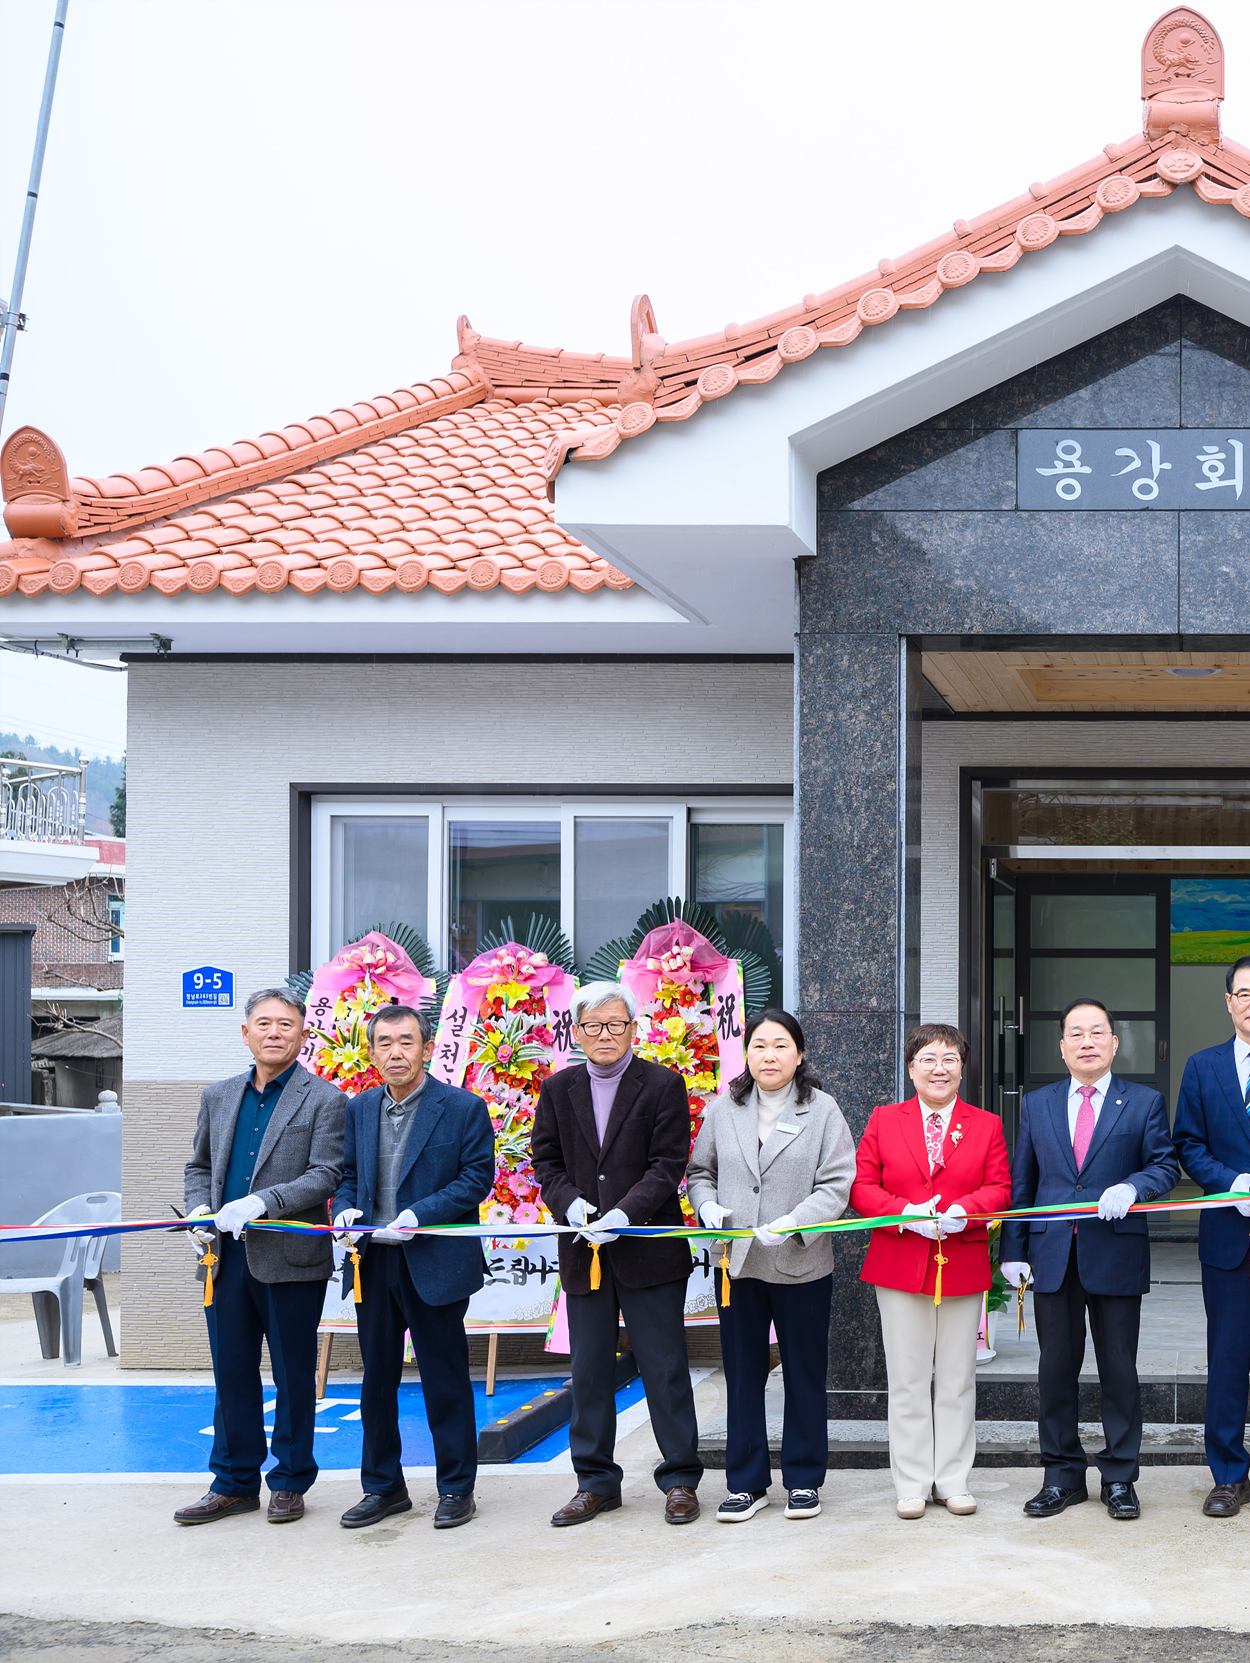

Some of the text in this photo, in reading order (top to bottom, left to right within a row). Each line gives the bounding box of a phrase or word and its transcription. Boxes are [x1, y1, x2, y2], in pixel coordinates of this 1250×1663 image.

[193, 972, 222, 989] 9-5
[552, 1009, 577, 1053] 祝
[717, 993, 741, 1041] 祝
